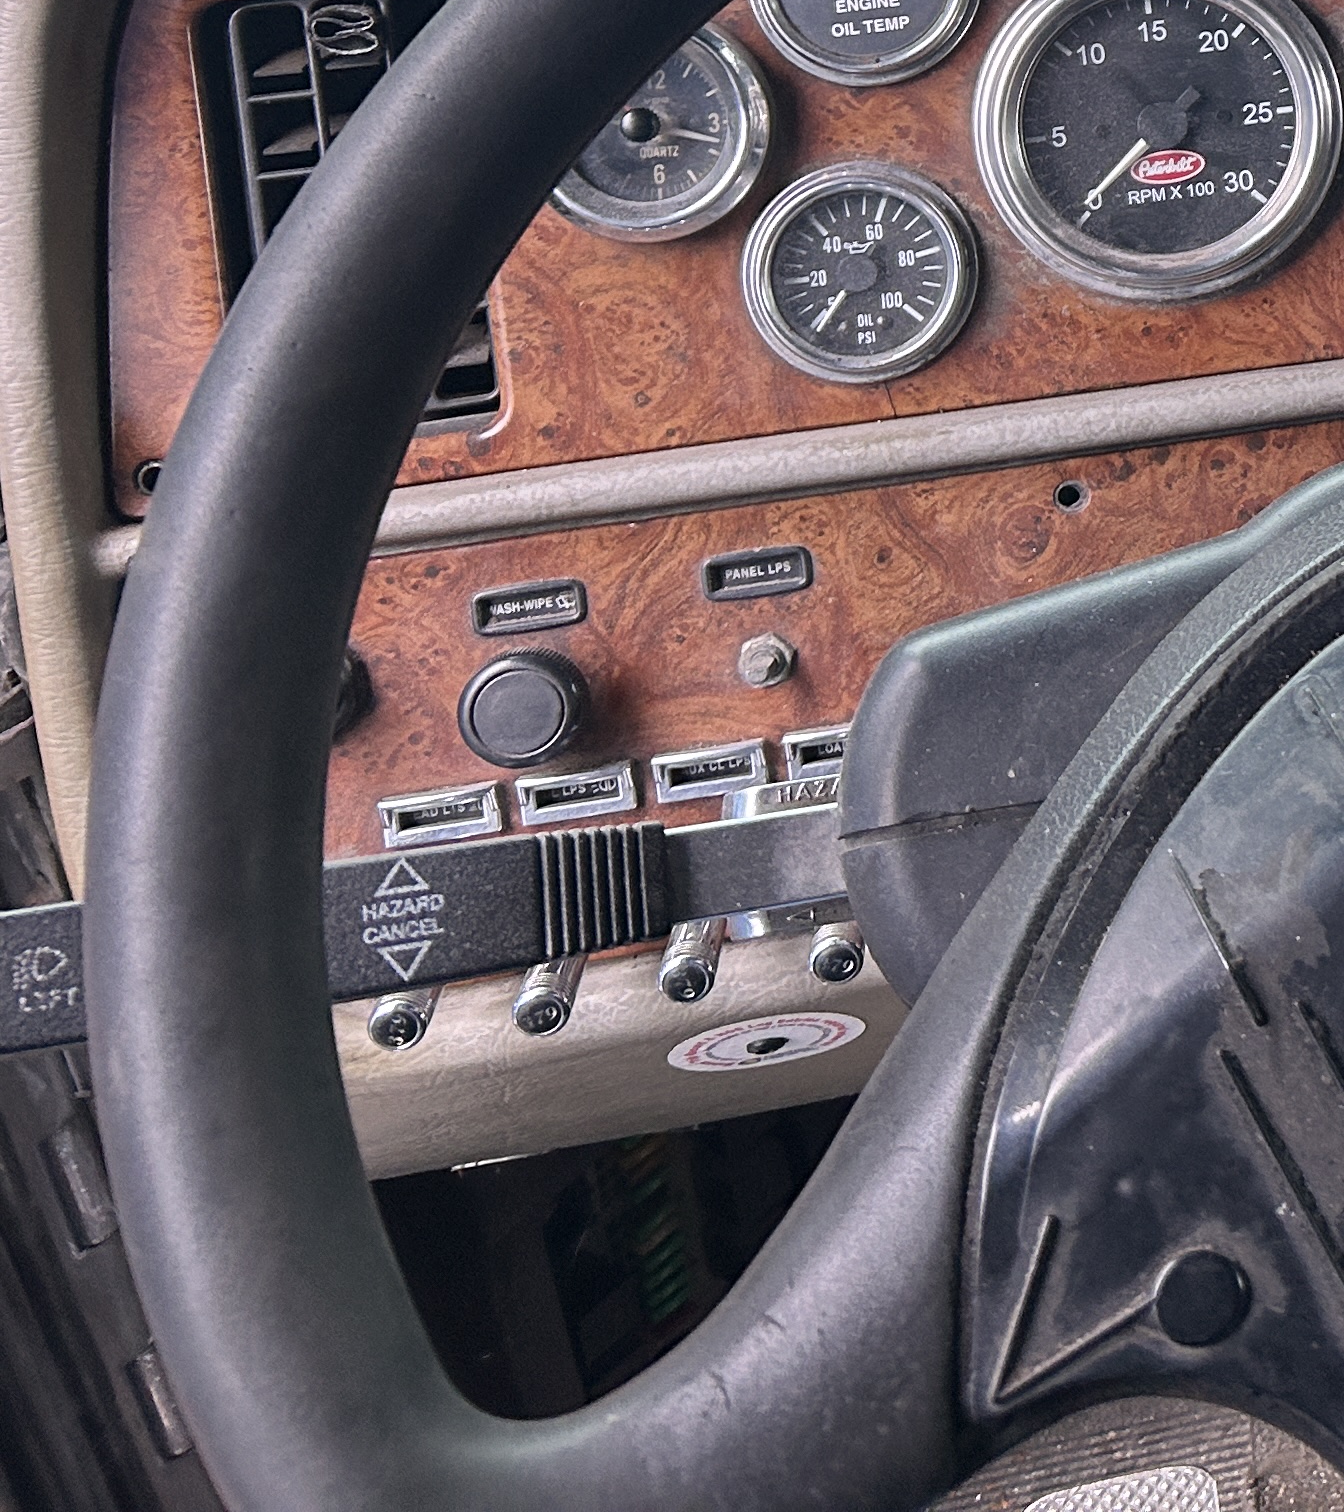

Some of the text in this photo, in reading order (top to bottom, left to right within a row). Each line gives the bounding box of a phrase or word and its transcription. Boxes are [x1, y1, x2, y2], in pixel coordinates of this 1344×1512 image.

[832, 15, 910, 38] OIL TEMP
[1138, 19, 1168, 42] 15
[1198, 29, 1230, 53] 20
[1076, 42, 1106, 66] 10
[708, 112, 720, 133] 3
[1242, 101, 1273, 126] 25
[1051, 126, 1067, 148] 5
[640, 145, 680, 159] QUARTZ
[653, 164, 666, 184] 6
[1137, 156, 1197, 179] Peterbilt
[1224, 169, 1254, 192] 30
[1128, 180, 1216, 205] RPM X 100
[866, 223, 884, 240] 60
[822, 236, 842, 254] 40
[898, 250, 915, 268] 80
[810, 269, 827, 288] 20
[881, 292, 902, 309] 100
[857, 314, 874, 328] OIL
[858, 331, 876, 344] PSI
[724, 560, 792, 581] PANEL LPS
[710, 760, 725, 772] CL
[562, 784, 586, 796] LPS
[360, 893, 446, 922] HAZARD
[362, 918, 445, 944] CANCEL
